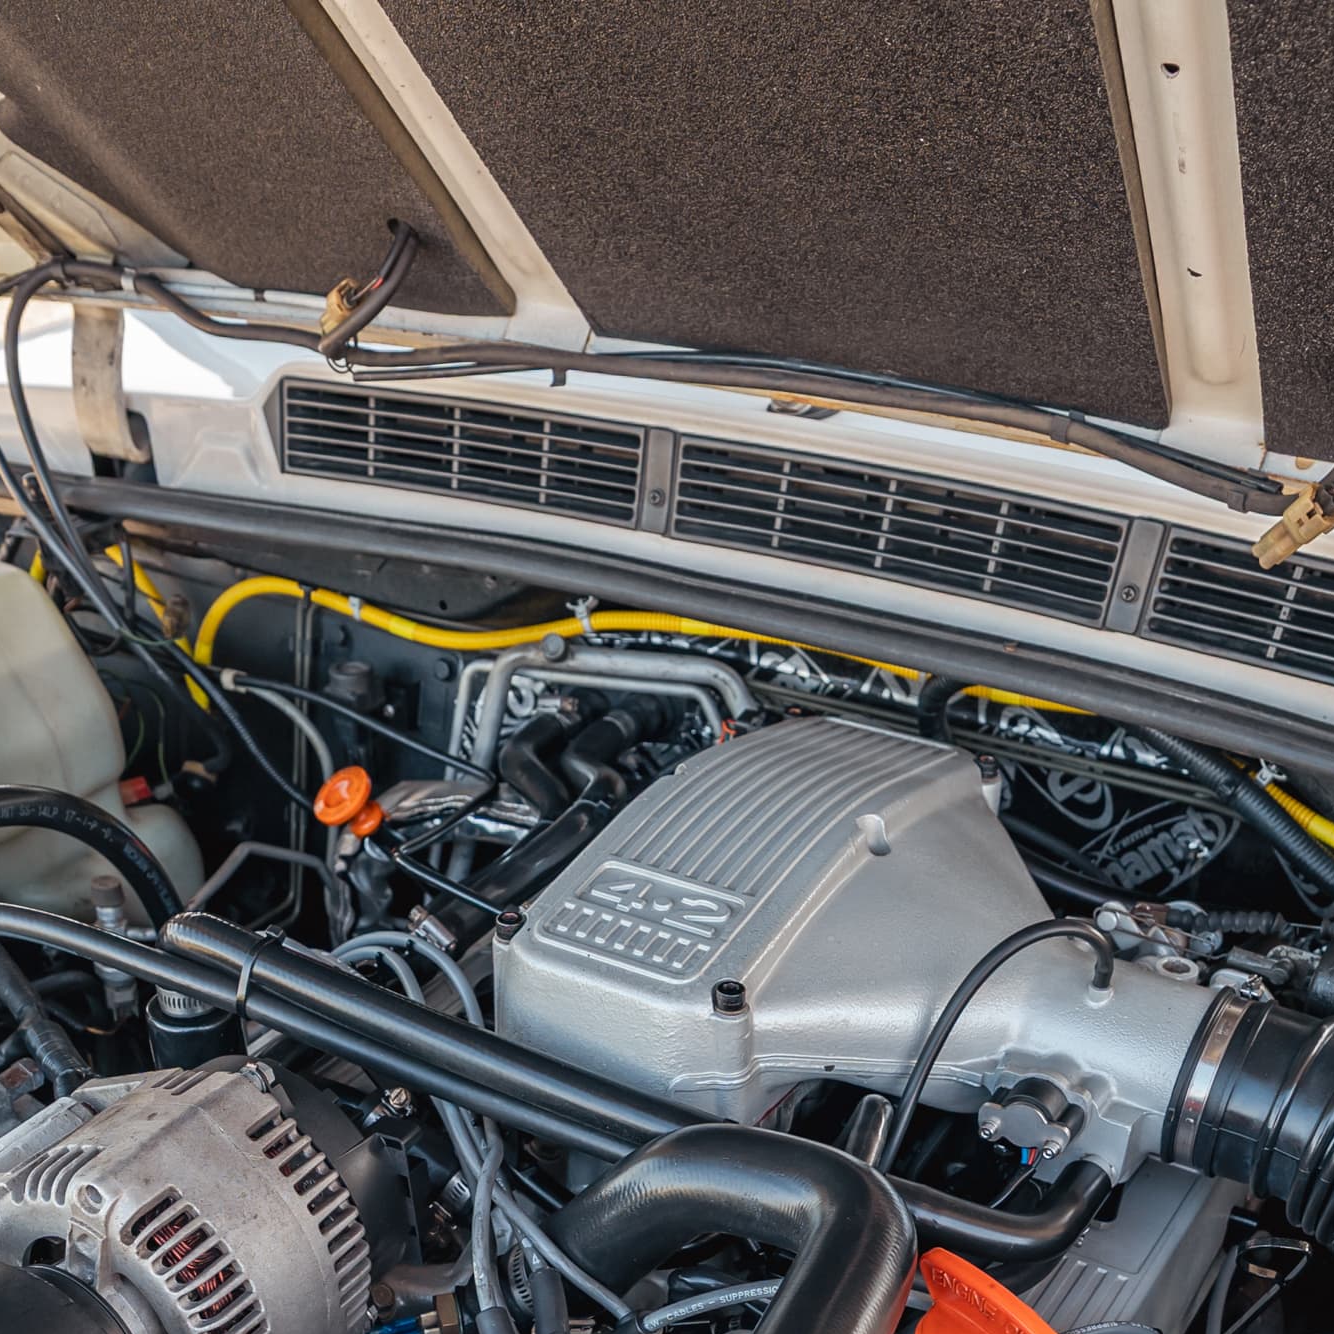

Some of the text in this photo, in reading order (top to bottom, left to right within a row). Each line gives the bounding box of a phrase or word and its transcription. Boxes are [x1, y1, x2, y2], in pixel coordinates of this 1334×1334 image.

[1104, 806, 1227, 889] namat
[666, 1302, 706, 1321] CABLES
[719, 1285, 779, 1304] SUPPRESSIO
[930, 1266, 999, 1322] ENGINE
